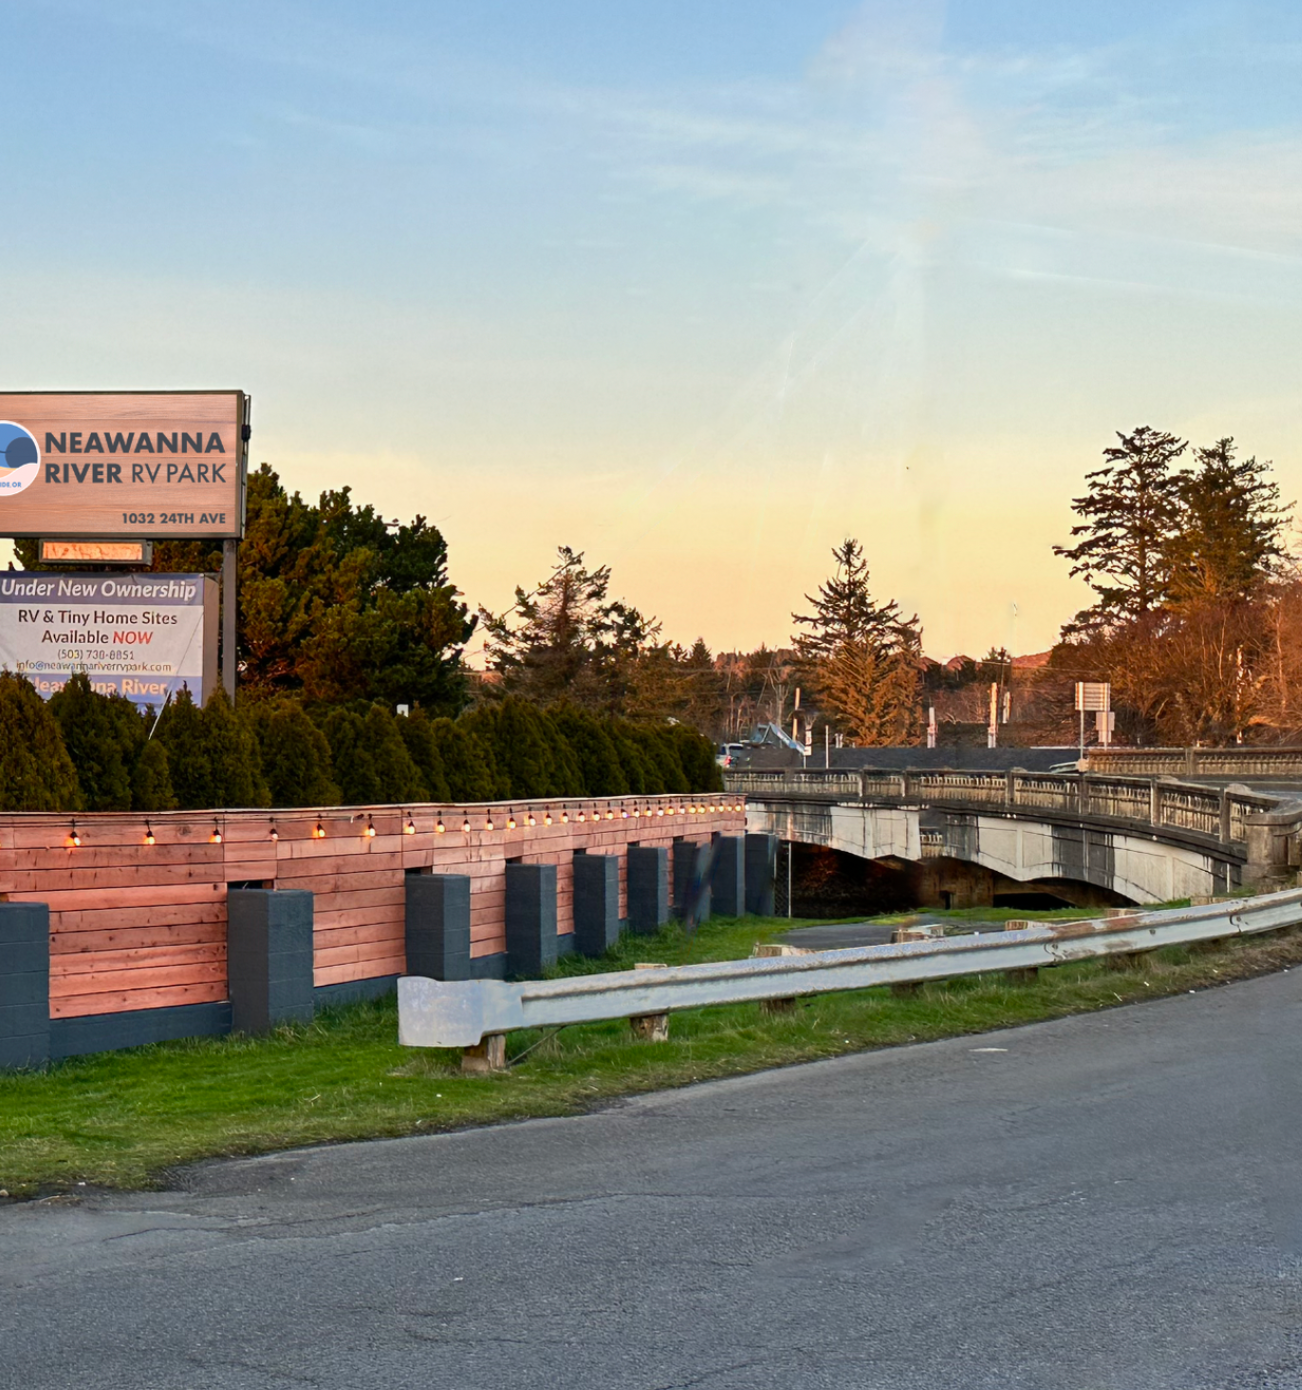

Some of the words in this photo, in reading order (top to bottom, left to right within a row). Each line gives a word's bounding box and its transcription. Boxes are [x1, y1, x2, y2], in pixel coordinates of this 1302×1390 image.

[45, 432, 226, 453] NEAWANNA
[45, 463, 123, 483] RIVER
[132, 463, 161, 484] RV
[167, 462, 226, 484] PARK
[122, 513, 155, 524] 1032
[159, 513, 194, 524] 24TH
[199, 513, 226, 524] AVE
[1, 578, 55, 597] Under
[58, 580, 98, 597] New
[101, 580, 197, 602] Ownership
[18, 609, 40, 623] RV
[43, 610, 54, 623] &
[58, 610, 90, 627] Tiny
[94, 611, 138, 624] Home
[142, 611, 178, 625] Sites
[42, 630, 109, 644] Available
[112, 631, 153, 645] NOW
[57, 649, 84, 661] (503)
[122, 679, 168, 695] River
